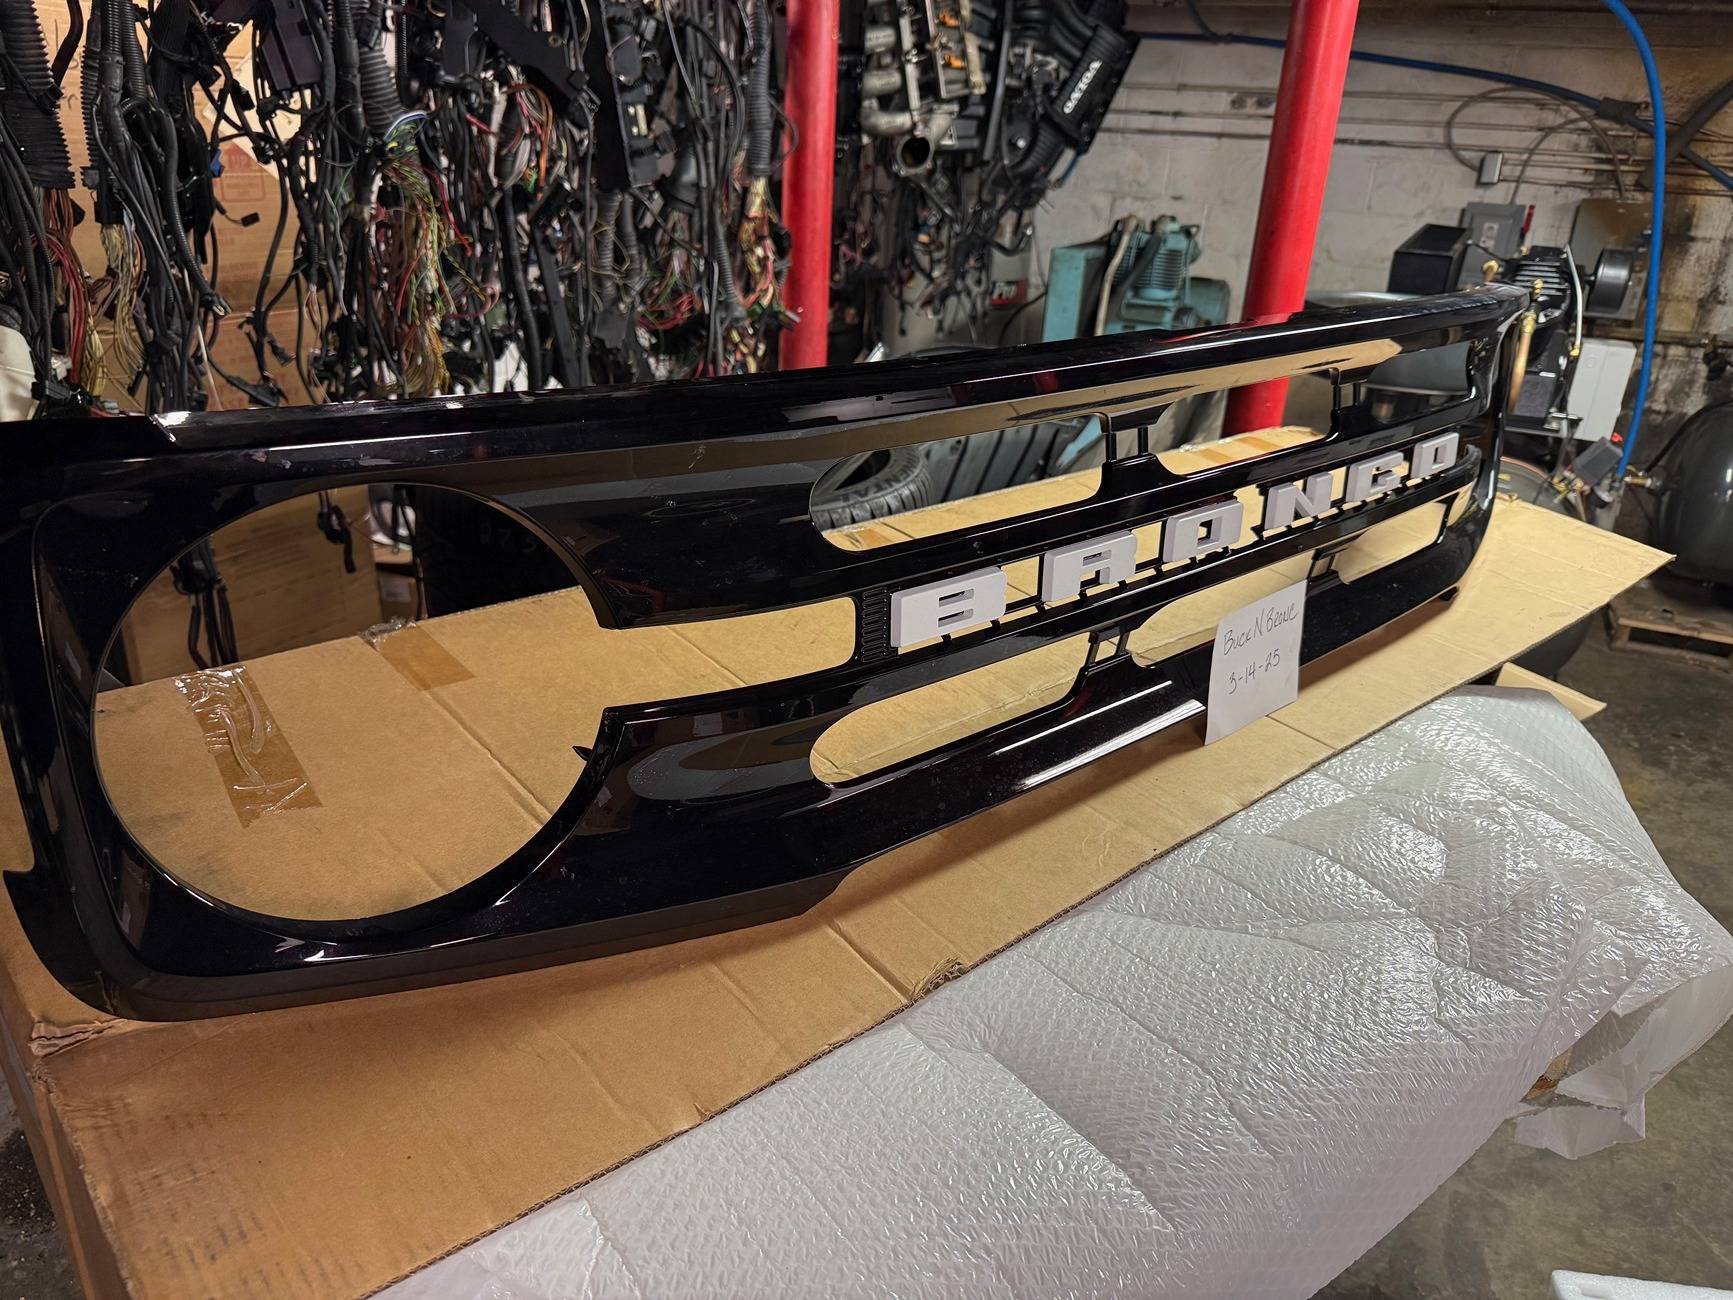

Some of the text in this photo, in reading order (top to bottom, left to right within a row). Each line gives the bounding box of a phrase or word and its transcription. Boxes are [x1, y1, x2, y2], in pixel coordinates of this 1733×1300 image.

[890, 431, 1460, 648] BRONCO
[1253, 607, 1265, 638] N
[1228, 648, 1281, 695] 3-14-25
